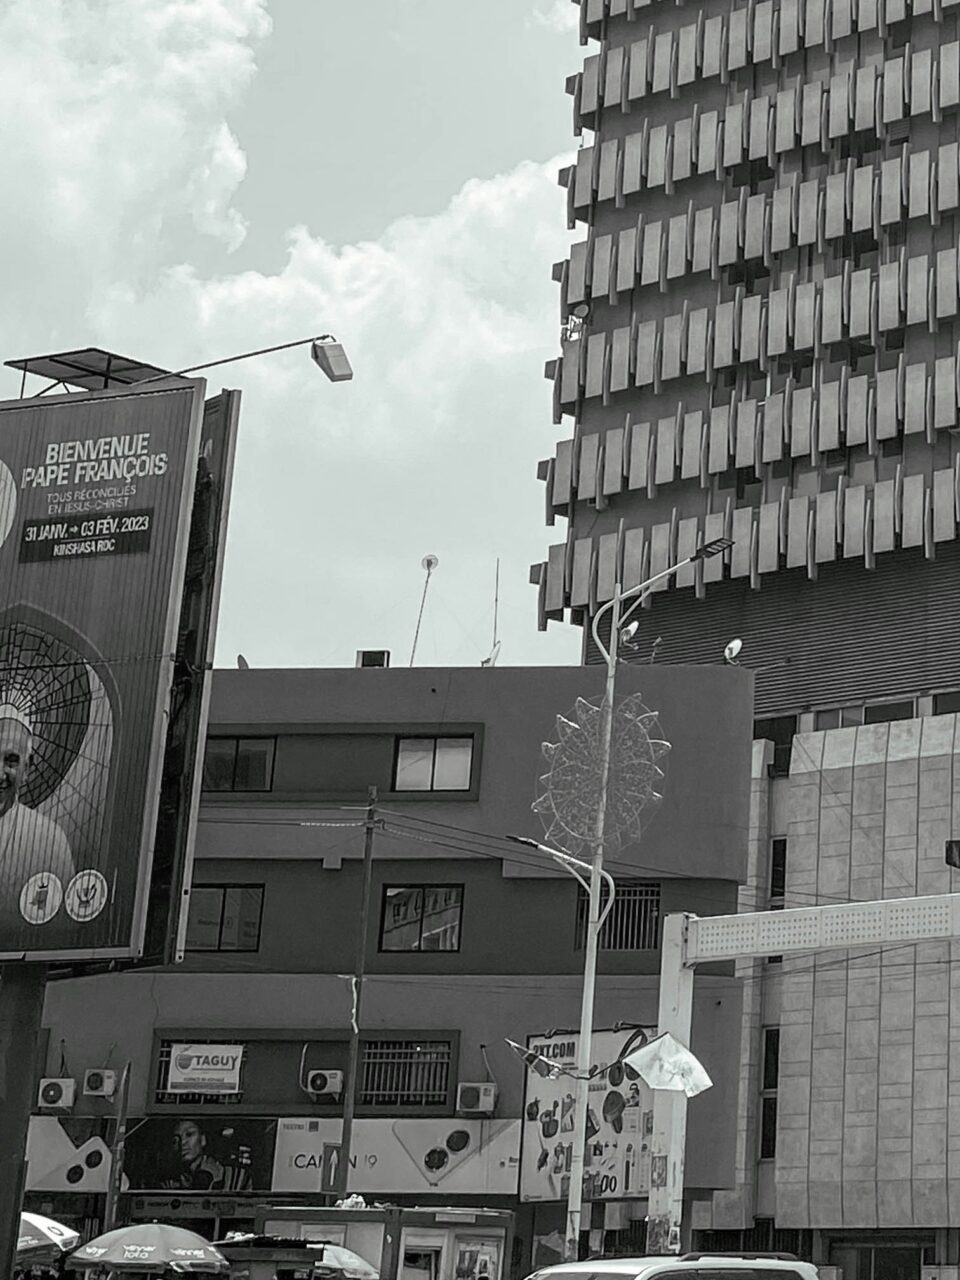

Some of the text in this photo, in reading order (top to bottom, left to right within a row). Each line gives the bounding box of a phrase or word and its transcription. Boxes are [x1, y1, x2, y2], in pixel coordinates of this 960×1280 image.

[45, 432, 151, 465] BIENVENUE
[20, 452, 169, 489] PAPE FRANÇOIS
[47, 491, 73, 503] TOUS
[48, 504, 62, 515] EN
[25, 515, 150, 542] 31 JANV. 03 FÉV. 2023
[53, 538, 116, 556] KINSHASA RDC
[193, 1054, 239, 1071] TAGUY
